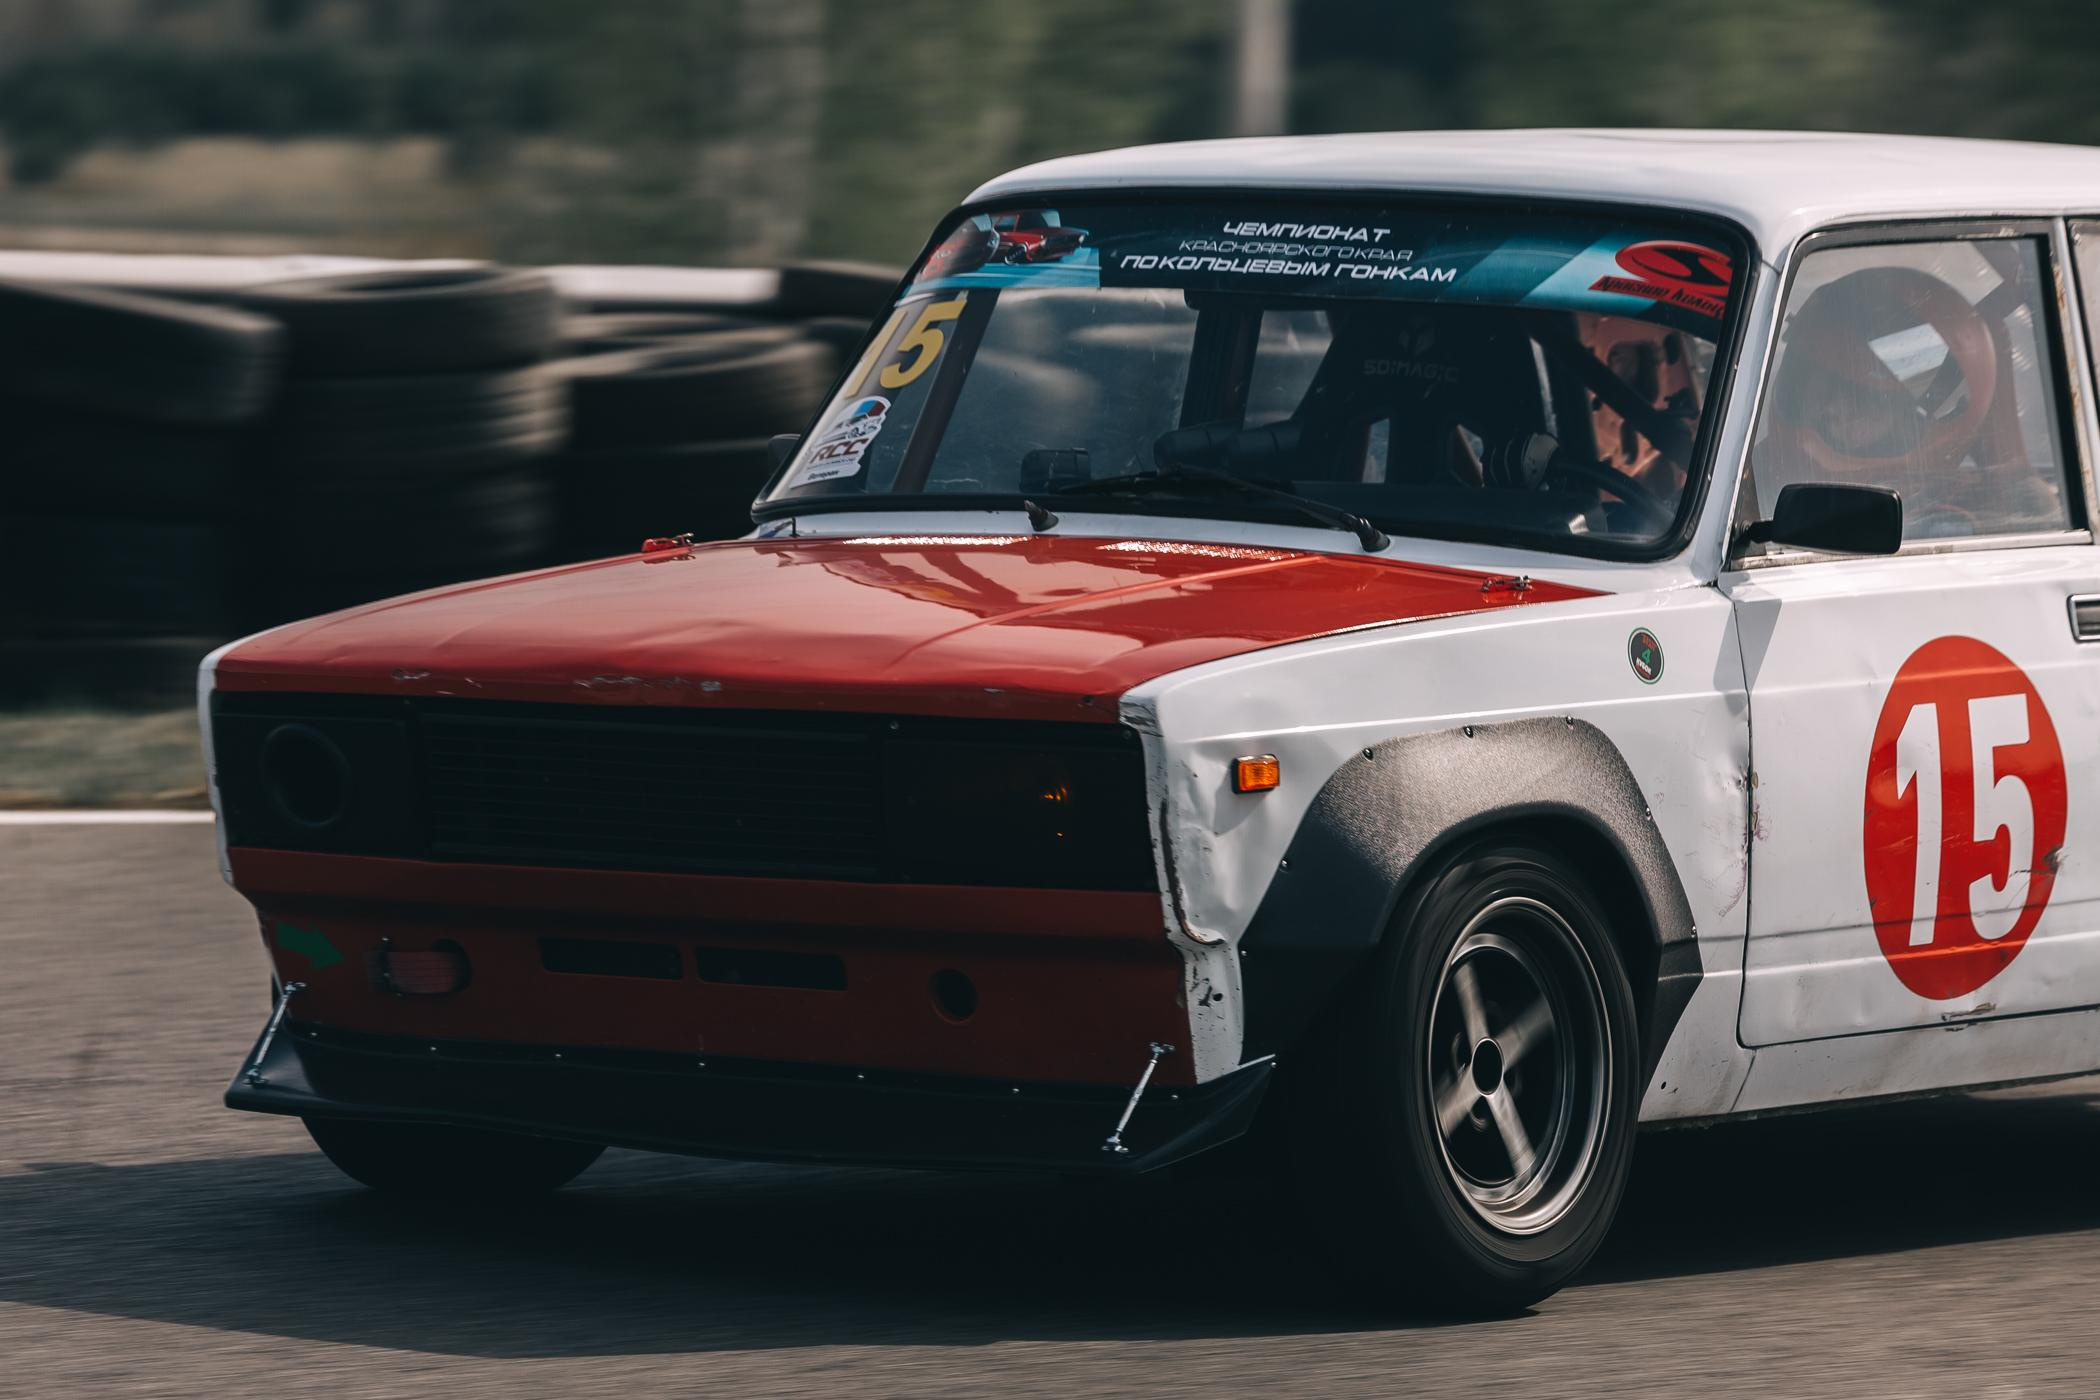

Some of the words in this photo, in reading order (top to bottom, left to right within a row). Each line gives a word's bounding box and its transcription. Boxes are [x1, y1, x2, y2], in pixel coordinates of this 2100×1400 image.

[1223, 221, 1391, 243] ЧЕМПИОНАТ
[1120, 255, 1158, 269] ПО
[1157, 255, 1330, 277] КОЛЬЦЕВЫМ
[1334, 263, 1457, 283] ГОНКАМ
[844, 298, 969, 400] 15
[811, 438, 869, 463] RCC
[1896, 693, 2034, 946] 15
